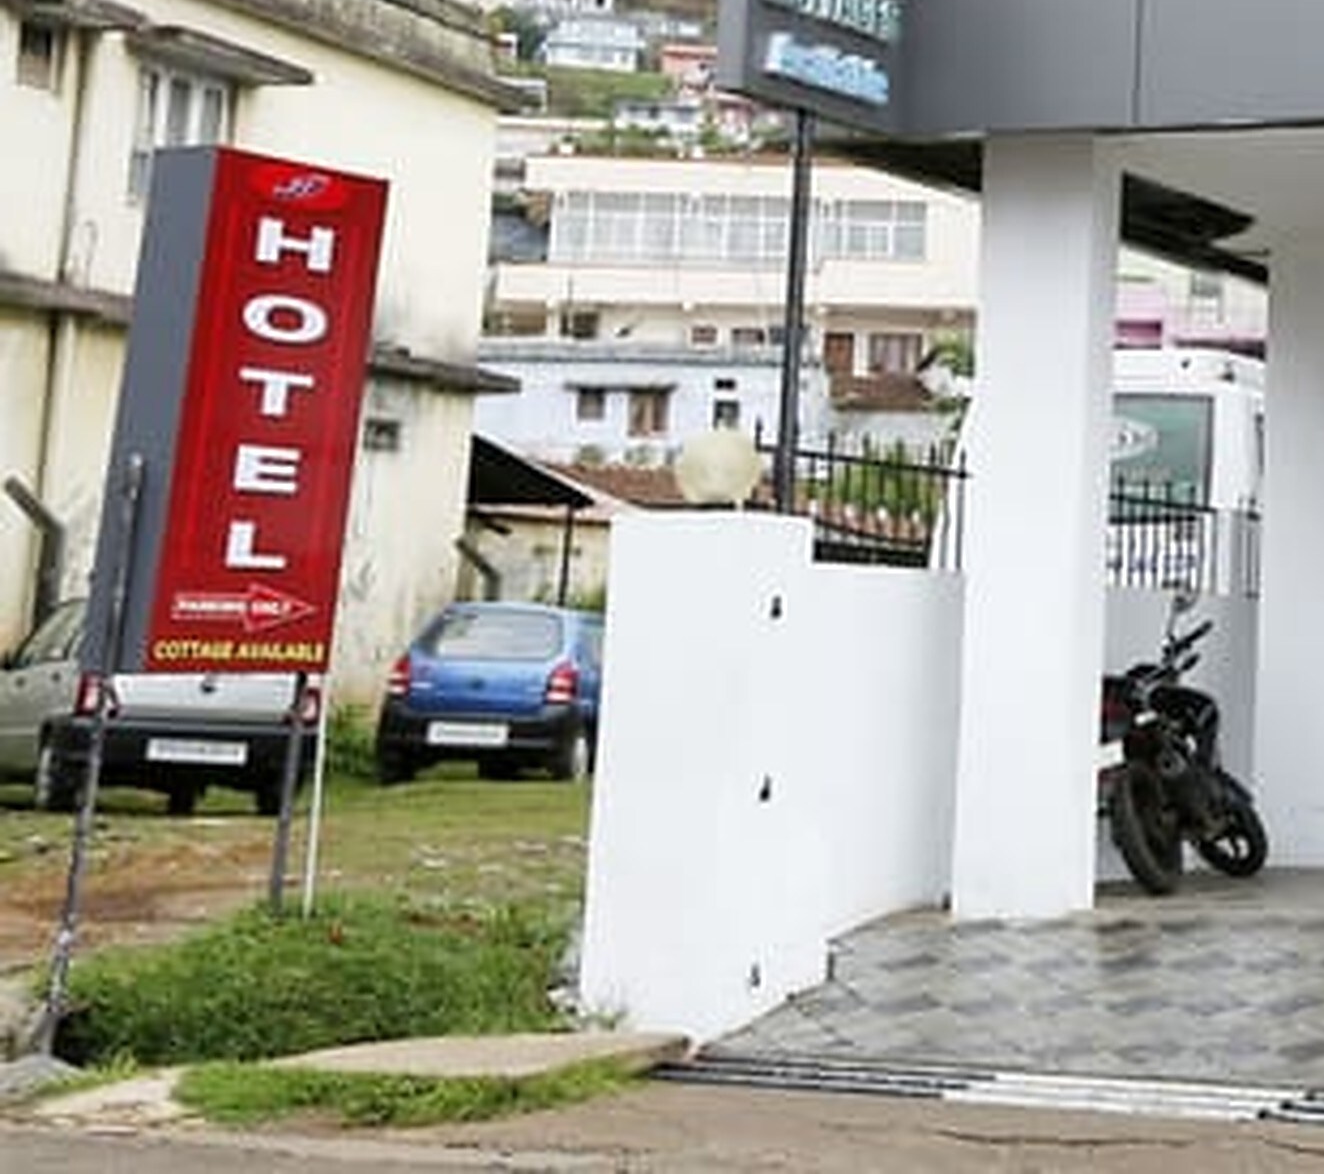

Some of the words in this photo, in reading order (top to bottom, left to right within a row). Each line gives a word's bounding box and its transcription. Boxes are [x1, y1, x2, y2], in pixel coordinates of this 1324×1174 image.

[225, 217, 335, 569] HOTEL
[153, 639, 234, 660] COTTAGE
[236, 642, 326, 663] AVAILABLE
